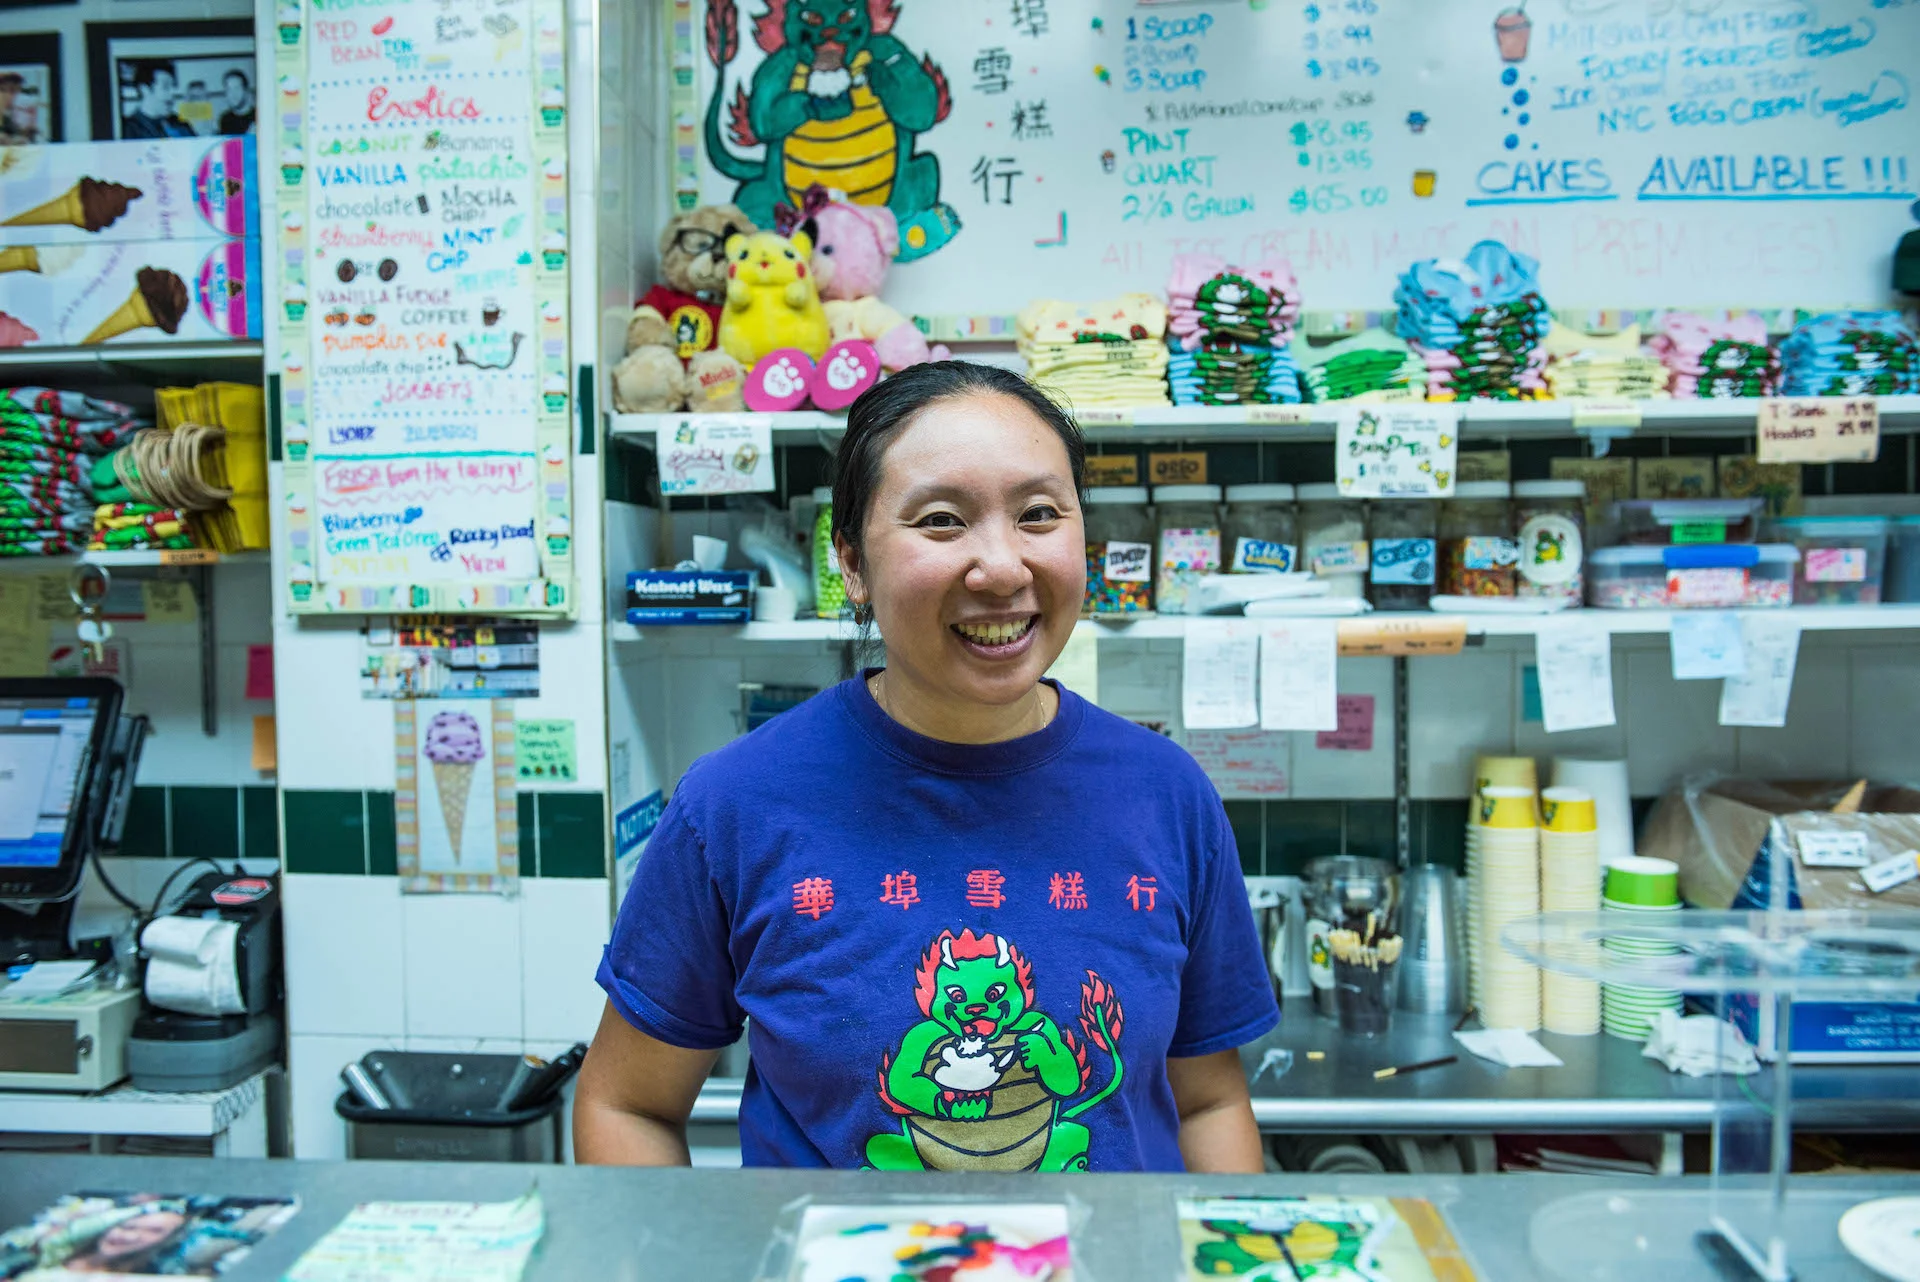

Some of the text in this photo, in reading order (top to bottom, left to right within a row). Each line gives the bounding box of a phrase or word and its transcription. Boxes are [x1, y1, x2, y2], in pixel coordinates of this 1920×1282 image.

[315, 20, 358, 42] RED
[1126, 16, 1138, 41] 1
[331, 41, 380, 65] BEAN
[367, 85, 482, 121] Exotics
[1597, 104, 1655, 135] NYC
[439, 133, 514, 152] Banana
[1121, 128, 1190, 155] PINT
[316, 163, 409, 187] VANILLA
[416, 152, 528, 186] pistachio
[1123, 156, 1218, 188] QUART
[1476, 159, 1613, 195] CAKES
[1637, 155, 1846, 193] AVAILABLE
[315, 195, 415, 220] chocolate
[441, 184, 519, 208] MOCHA
[442, 226, 498, 248] MINT
[317, 287, 390, 305] VANILLA
[400, 308, 470, 327] COFFEE
[321, 323, 410, 357] pumpkin
[322, 513, 401, 534] Blueberry
[449, 518, 535, 549] Rocky Road
[325, 533, 370, 555] Green
[374, 531, 400, 553] Tea
[459, 553, 507, 574] Yuzu
[697, 578, 734, 594] Wax
[792, 869, 1159, 921] 華埠雪糕行
